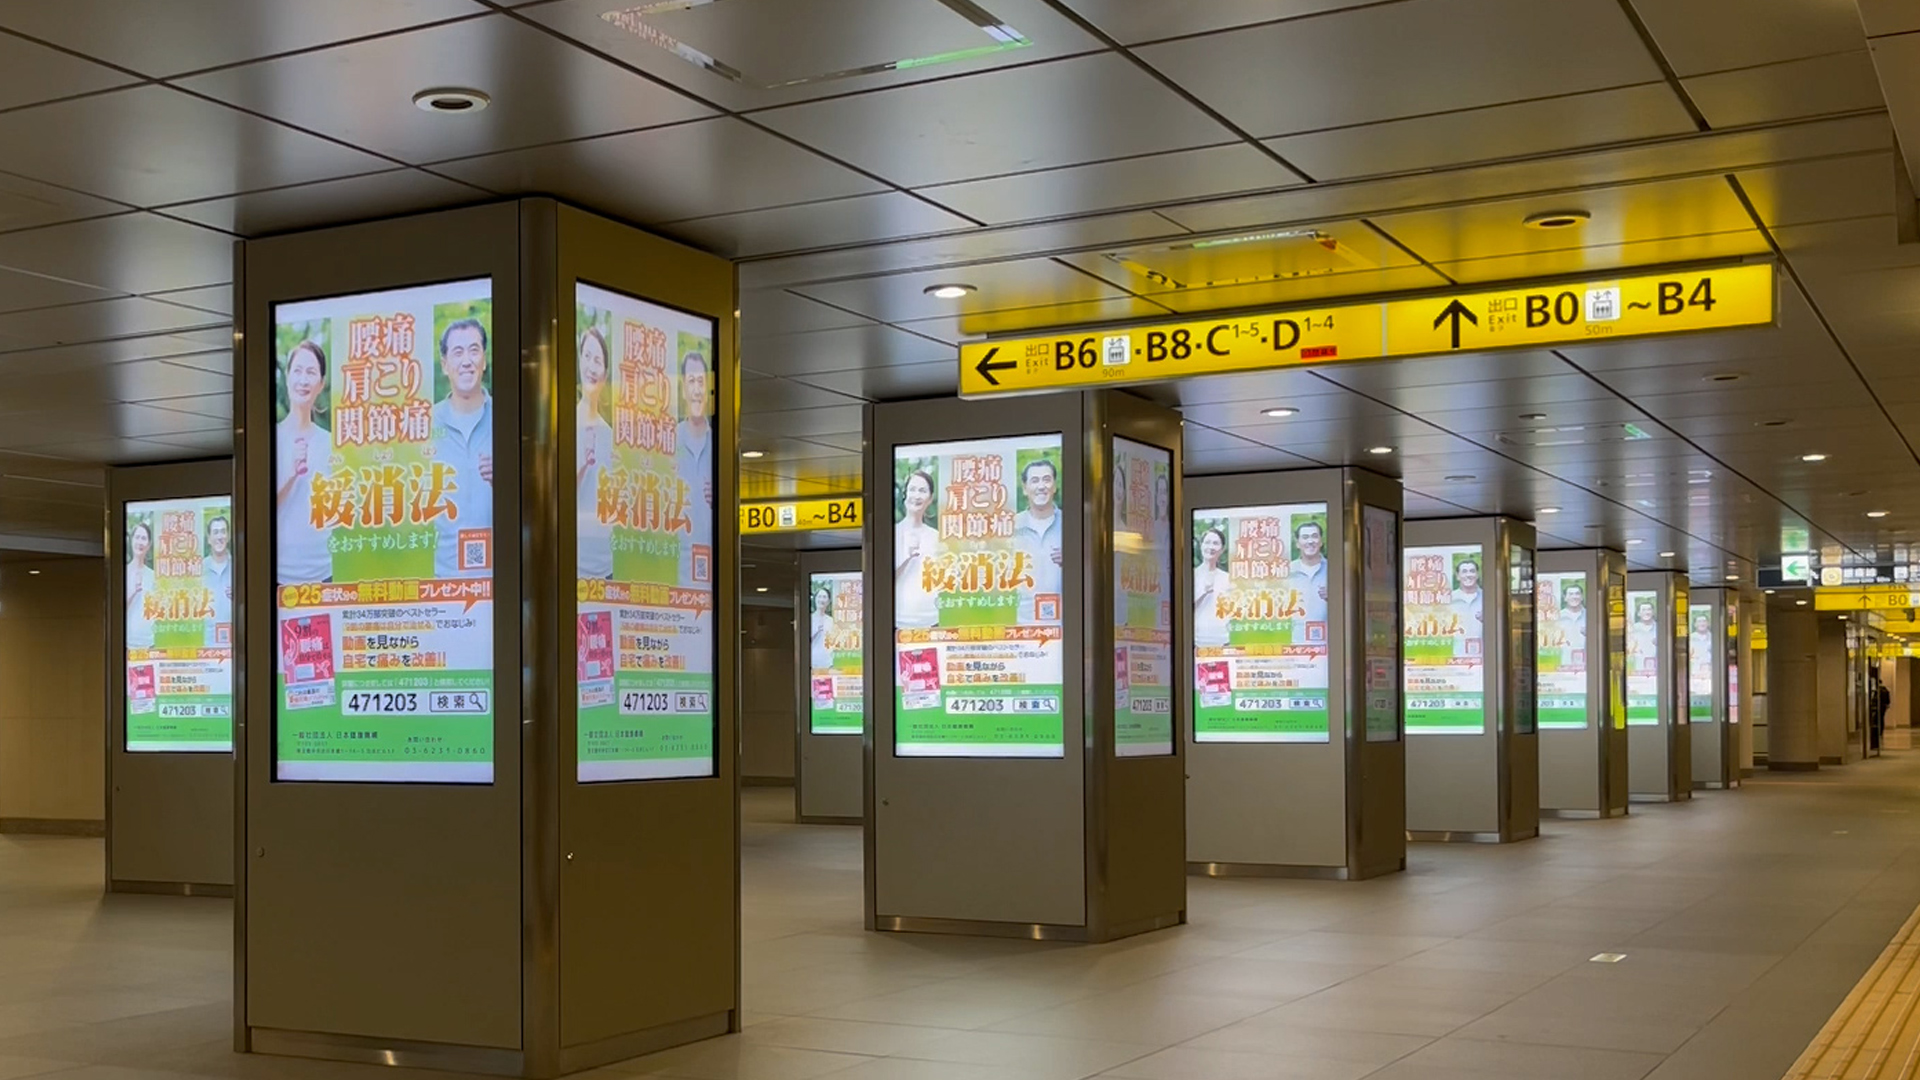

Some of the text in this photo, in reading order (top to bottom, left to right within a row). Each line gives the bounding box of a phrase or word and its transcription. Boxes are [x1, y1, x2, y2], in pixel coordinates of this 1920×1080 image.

[1489, 298, 1517, 313] 出口
[1527, 291, 1579, 328] B0
[1489, 313, 1516, 325] Exit
[1585, 325, 1613, 336] 50m
[349, 313, 414, 360] 腰痛
[624, 321, 667, 369] 腰痛
[1026, 343, 1049, 357] 出口
[1055, 338, 1097, 371] B6
[1026, 358, 1048, 368] Exit
[1102, 369, 1125, 378] 90m
[342, 357, 422, 403] 肩こり
[619, 362, 671, 411] 肩こり
[335, 402, 431, 447] 関節痛
[615, 405, 676, 455] 関節痛
[953, 455, 1002, 483] 腰痛
[309, 461, 458, 529] 緩消法
[596, 467, 692, 534] 緩消法
[946, 482, 1009, 511] 肩こり
[748, 507, 776, 528] B0
[940, 511, 1015, 540] 関節痛
[922, 551, 1034, 593] 緩消法
[342, 635, 419, 650] 動画を見ながら
[162, 706, 196, 715] 471203
[348, 693, 417, 711] 471203
[624, 693, 668, 711] 471203
[951, 699, 1004, 711] 471203
[1239, 699, 1282, 709] 471203
[1410, 699, 1445, 708] 471203
